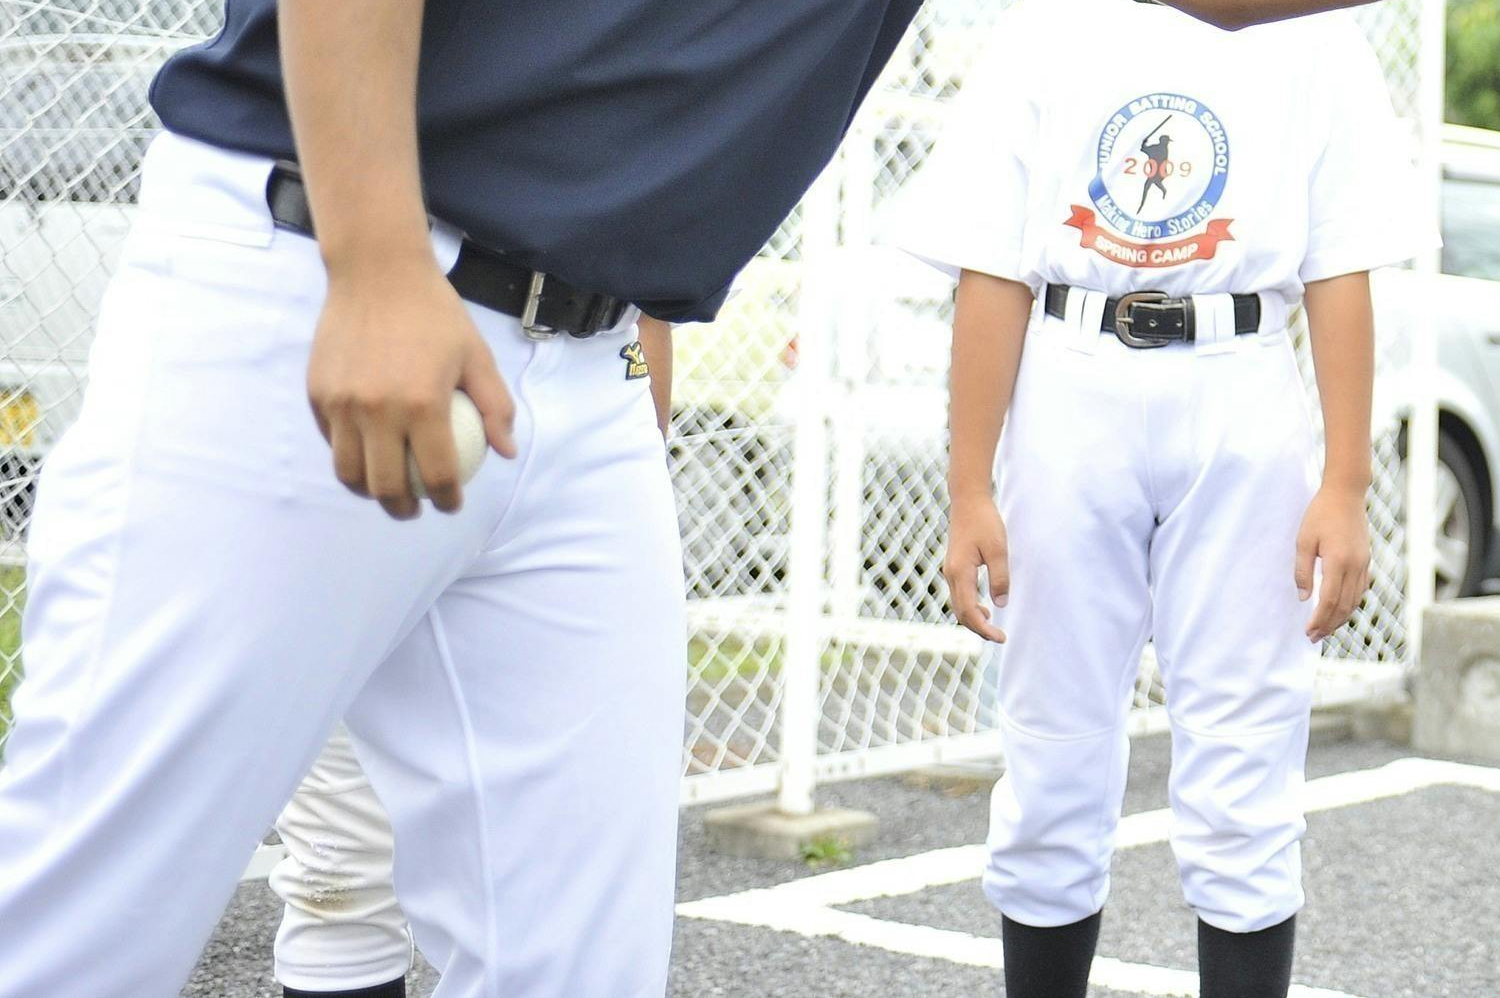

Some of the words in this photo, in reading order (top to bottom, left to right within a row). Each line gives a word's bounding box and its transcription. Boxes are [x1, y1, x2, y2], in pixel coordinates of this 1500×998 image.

[1098, 113, 1128, 167] UNIOR
[1129, 95, 1198, 115] BATTING
[1199, 111, 1228, 176] SCHOOL
[1123, 157, 1192, 178] 2009
[1096, 193, 1131, 232] Making
[1131, 219, 1162, 238] Hero
[1167, 200, 1213, 235] Stories
[1094, 234, 1148, 263] SPRING
[1150, 243, 1199, 264] CAMP
